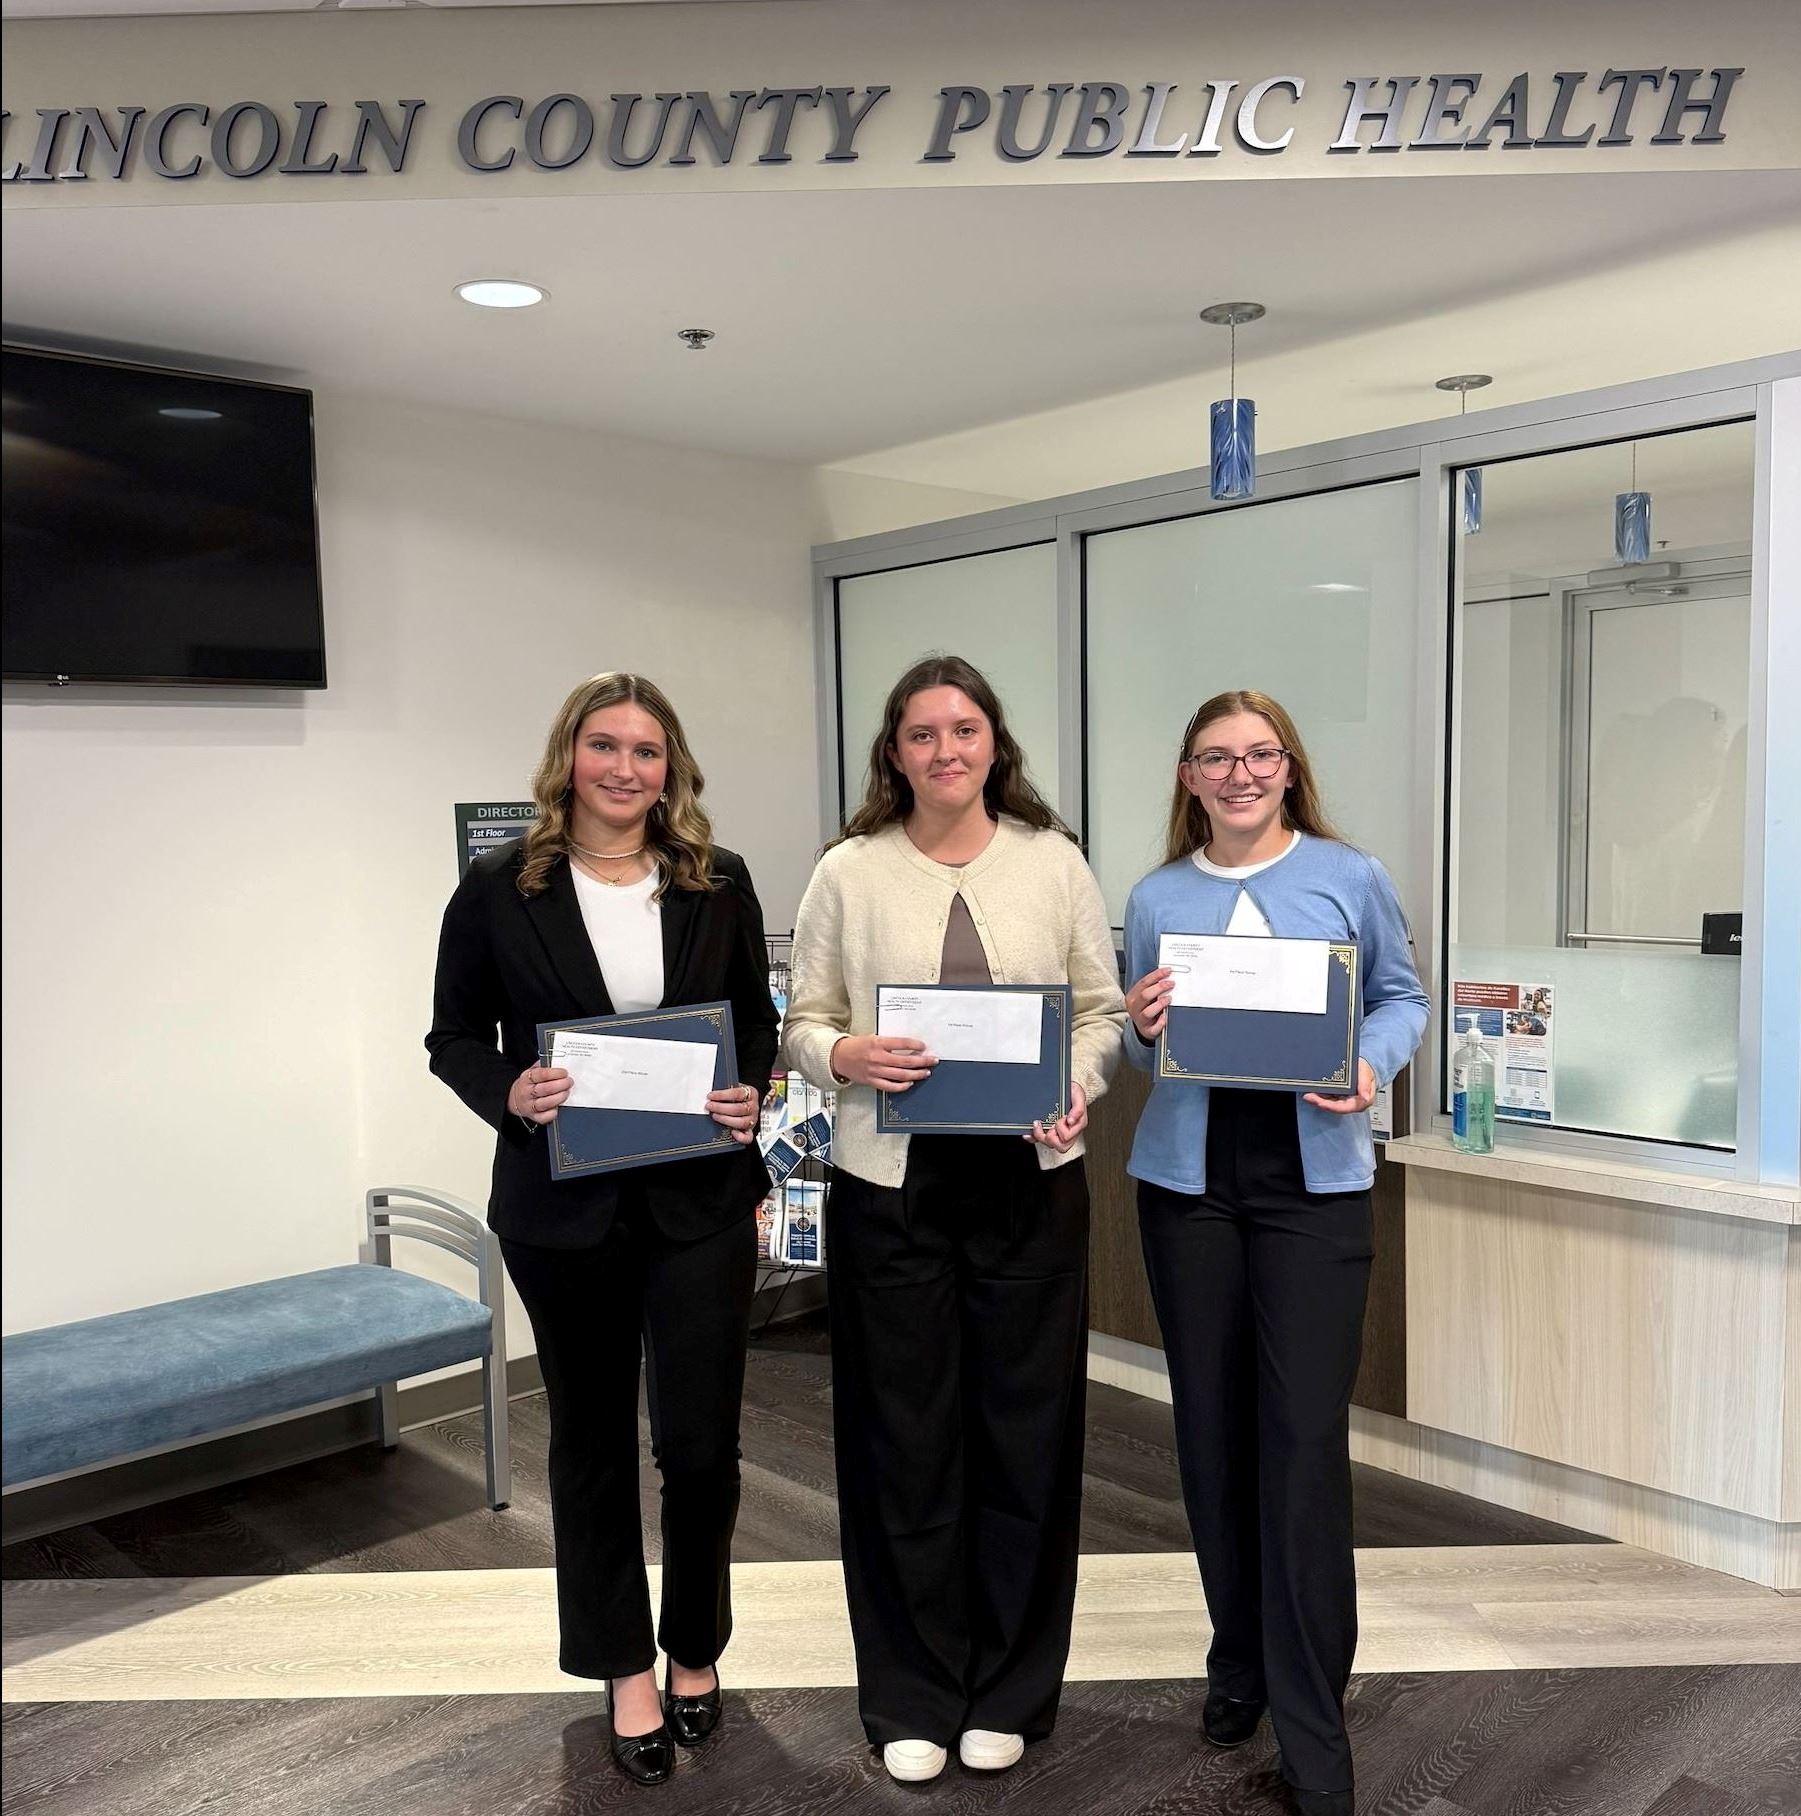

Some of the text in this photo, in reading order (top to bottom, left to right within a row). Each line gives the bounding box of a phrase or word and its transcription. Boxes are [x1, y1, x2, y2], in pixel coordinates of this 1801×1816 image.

[457, 86, 891, 171] COUNTY
[924, 76, 1307, 160] PUBLIC
[1329, 67, 1745, 153] HEALTH
[477, 807, 540, 818] DIRECTO
[472, 829, 506, 838] 1st Floor
